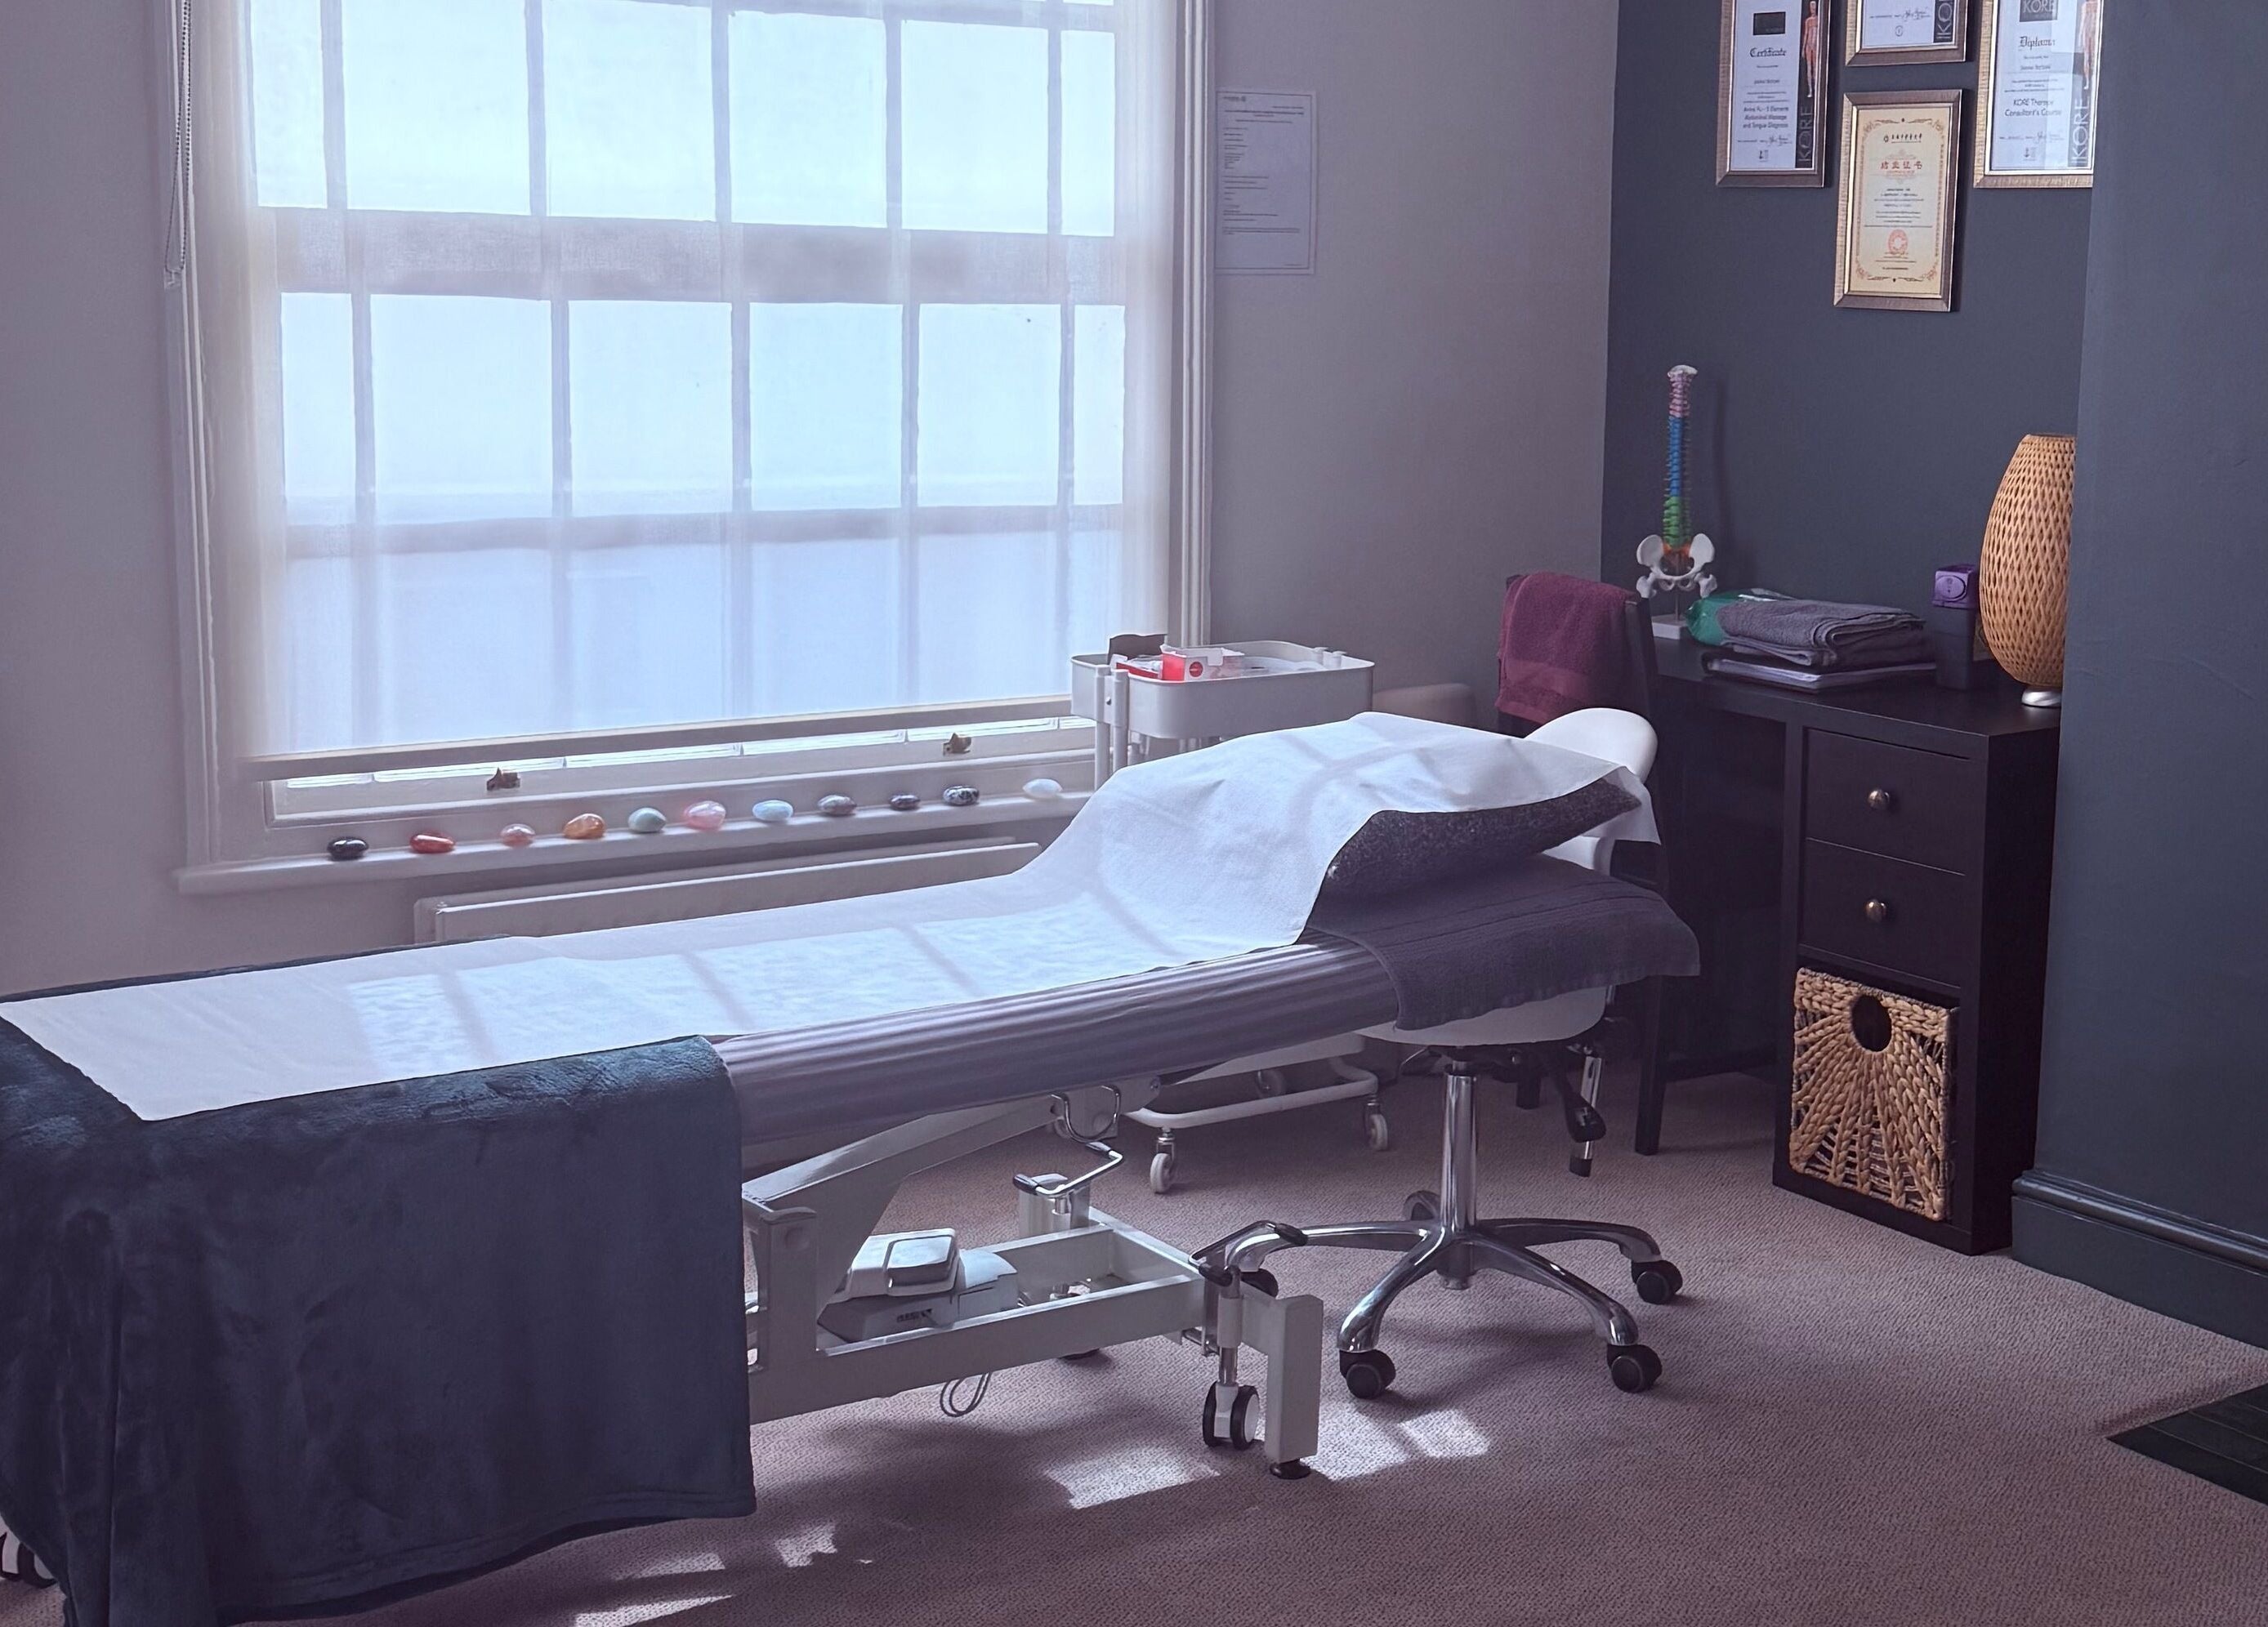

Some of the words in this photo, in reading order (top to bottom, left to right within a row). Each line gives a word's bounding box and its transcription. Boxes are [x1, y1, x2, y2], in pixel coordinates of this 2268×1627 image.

[1936, 0, 1953, 39] KO
[2022, 0, 2056, 13] KORE
[1798, 106, 1814, 162] KORE
[2072, 97, 2089, 163] KORE
